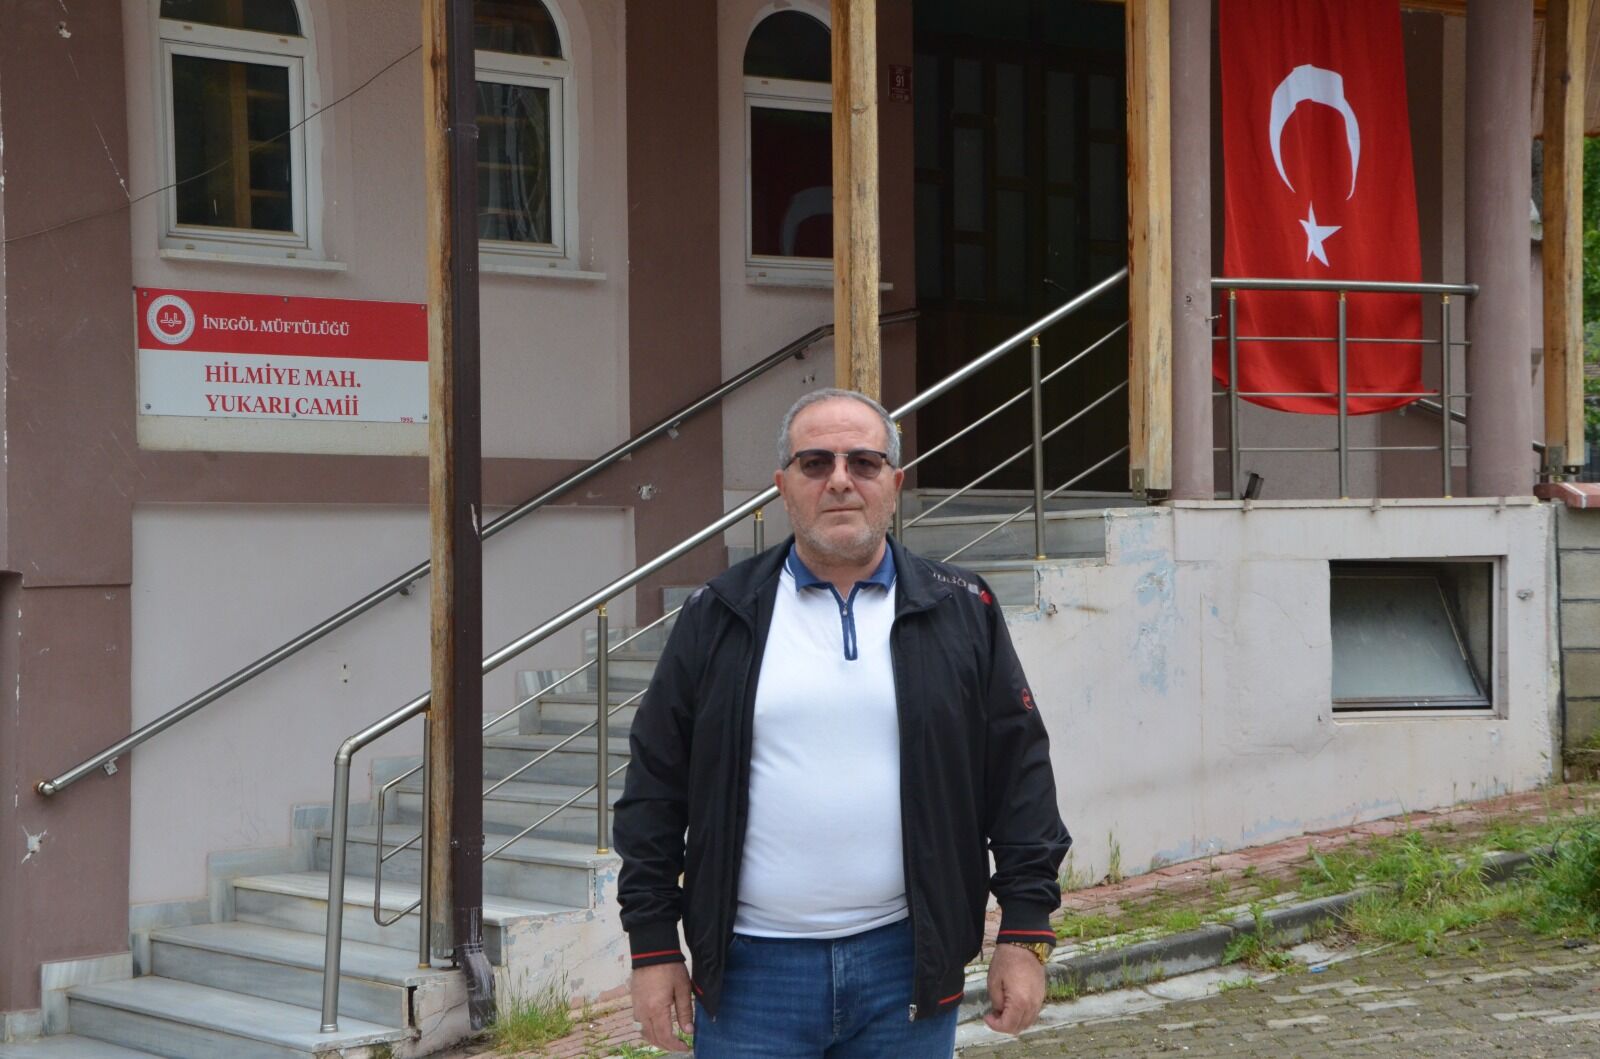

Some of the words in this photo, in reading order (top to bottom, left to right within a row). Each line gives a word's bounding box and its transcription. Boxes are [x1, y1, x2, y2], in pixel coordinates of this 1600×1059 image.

[895, 75, 905, 87] 91
[202, 313, 258, 332] İNEGÖL
[260, 317, 351, 336] MÜFTÜLÜĞÜ
[204, 361, 300, 386] HİLMİYE
[304, 368, 361, 389] MAH.
[205, 394, 290, 414] YUKARI
[295, 394, 359, 416] CAMİİ
